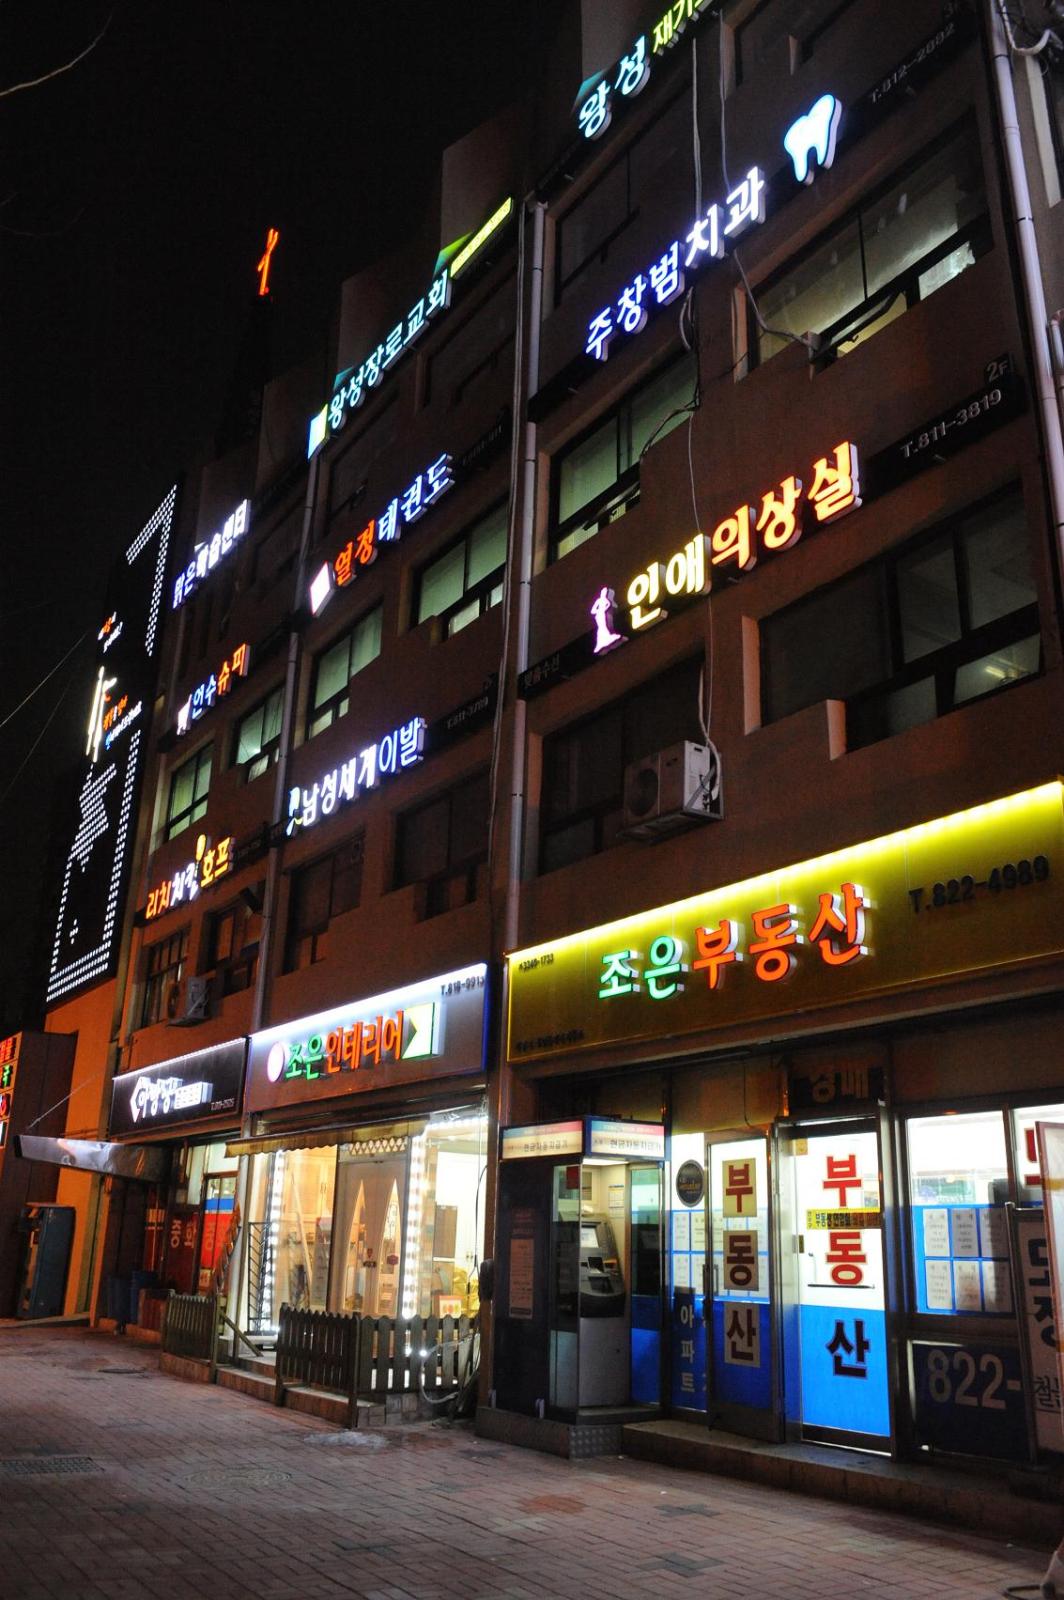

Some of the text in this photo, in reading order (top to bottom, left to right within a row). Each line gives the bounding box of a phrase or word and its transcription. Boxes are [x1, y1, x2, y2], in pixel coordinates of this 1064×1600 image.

[585, 165, 767, 360] 주창범치과
[328, 269, 452, 430] 왕성장로교회
[900, 388, 1002, 459] T.811-3819
[597, 882, 873, 1000] 조은부동산
